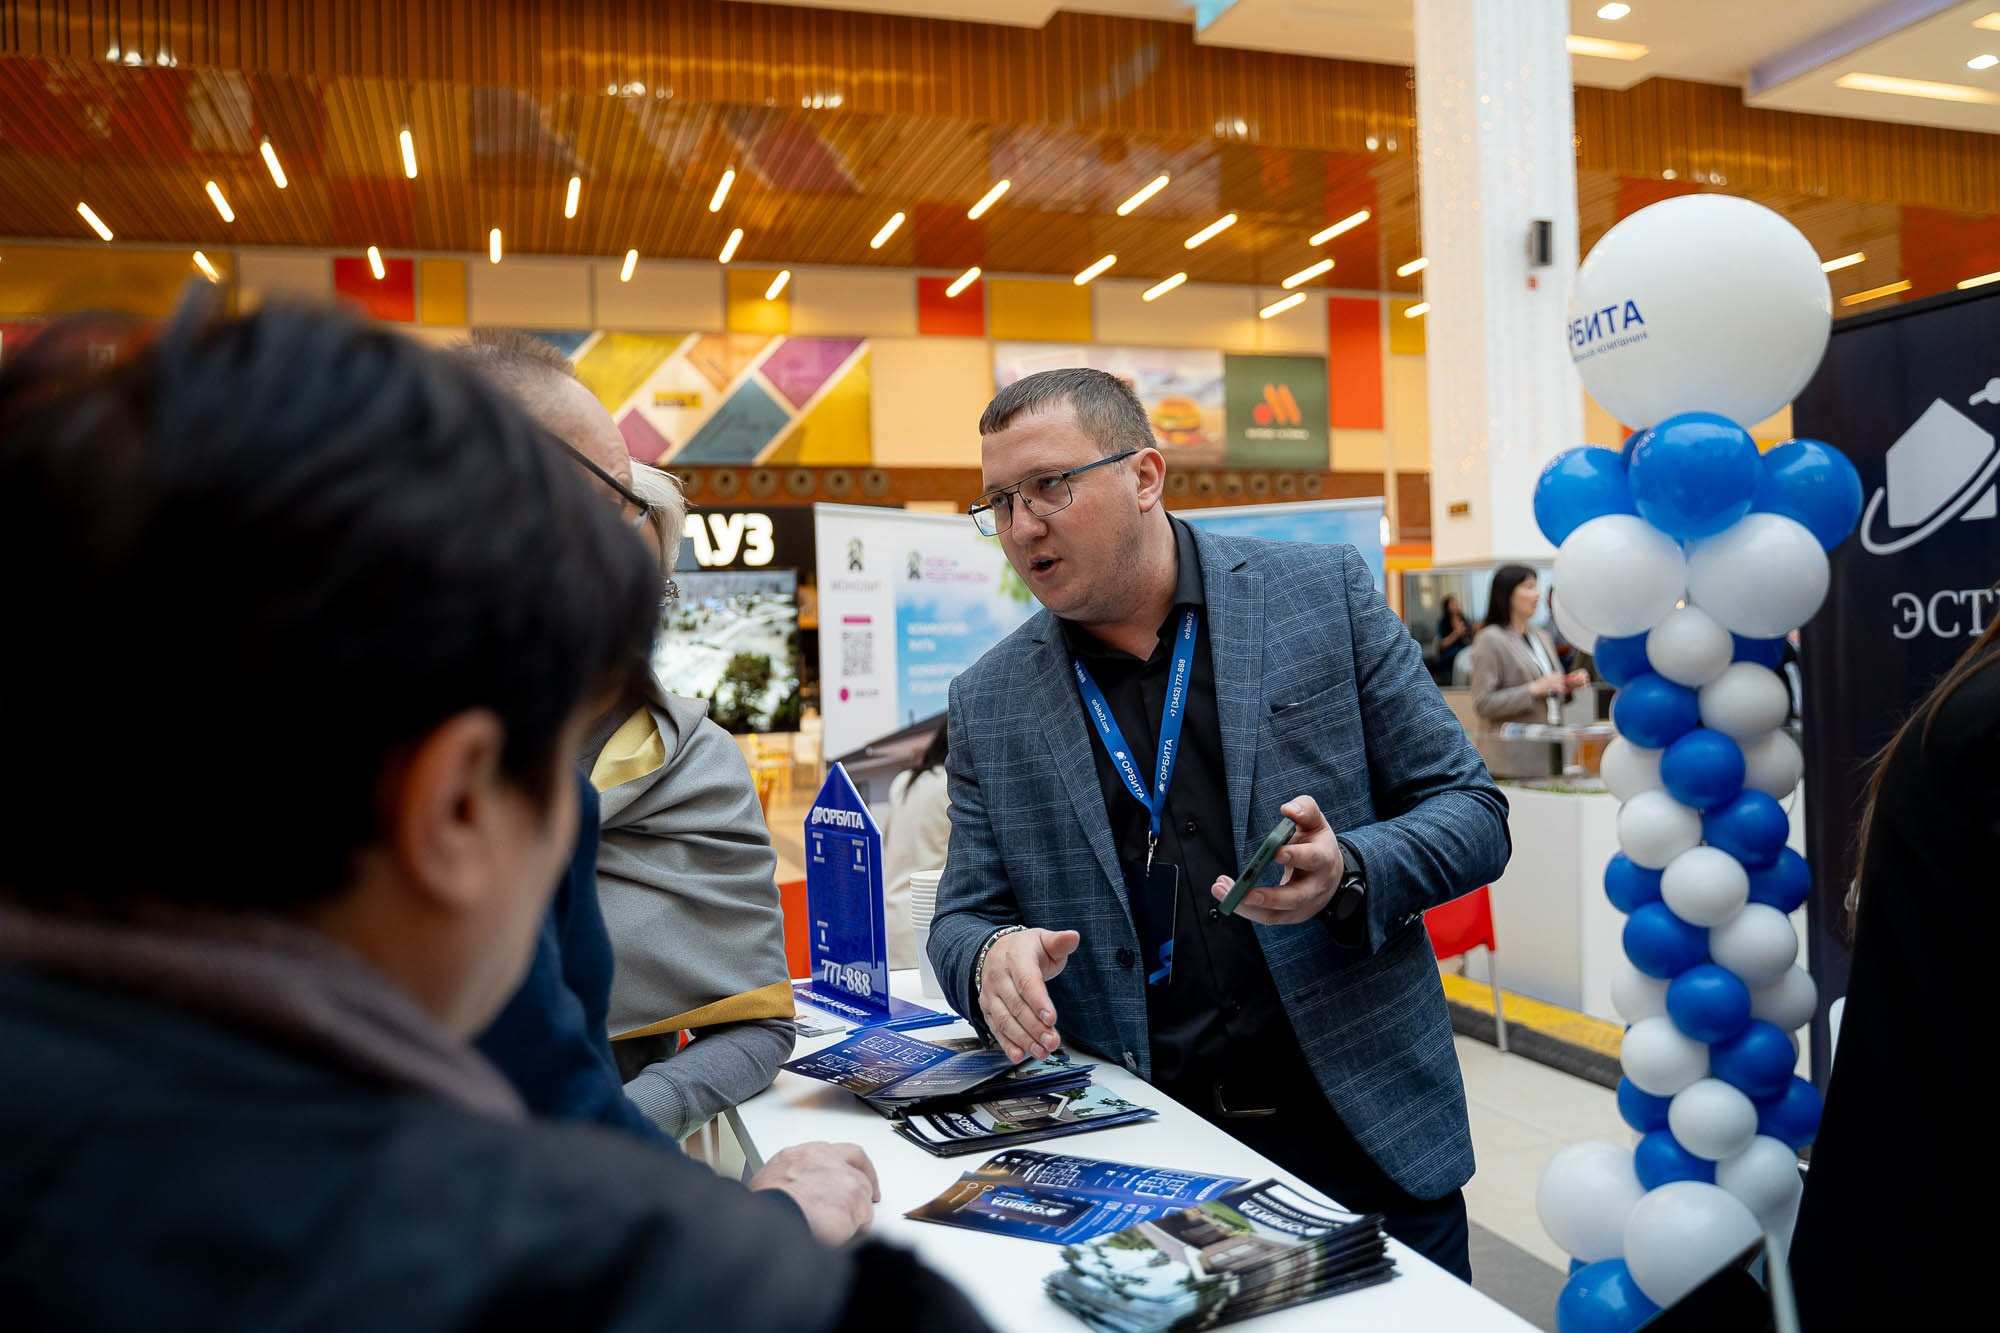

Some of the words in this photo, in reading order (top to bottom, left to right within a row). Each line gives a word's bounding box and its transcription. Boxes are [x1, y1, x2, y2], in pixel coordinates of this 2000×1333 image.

[1892, 588, 2000, 640] ЭСТ
[1175, 658, 1187, 687] 777-888
[1171, 687, 1183, 708] (3452)
[1091, 699, 1111, 734] orbita72.com
[1160, 738, 1174, 781] ОРБИТА
[1122, 760, 1145, 799] ОРБИТА
[822, 807, 865, 830] ОРБИТА
[820, 958, 872, 997] 777-888
[990, 1195, 1045, 1216] ОРБИТА
[1237, 1199, 1303, 1234] ОРБИТА
